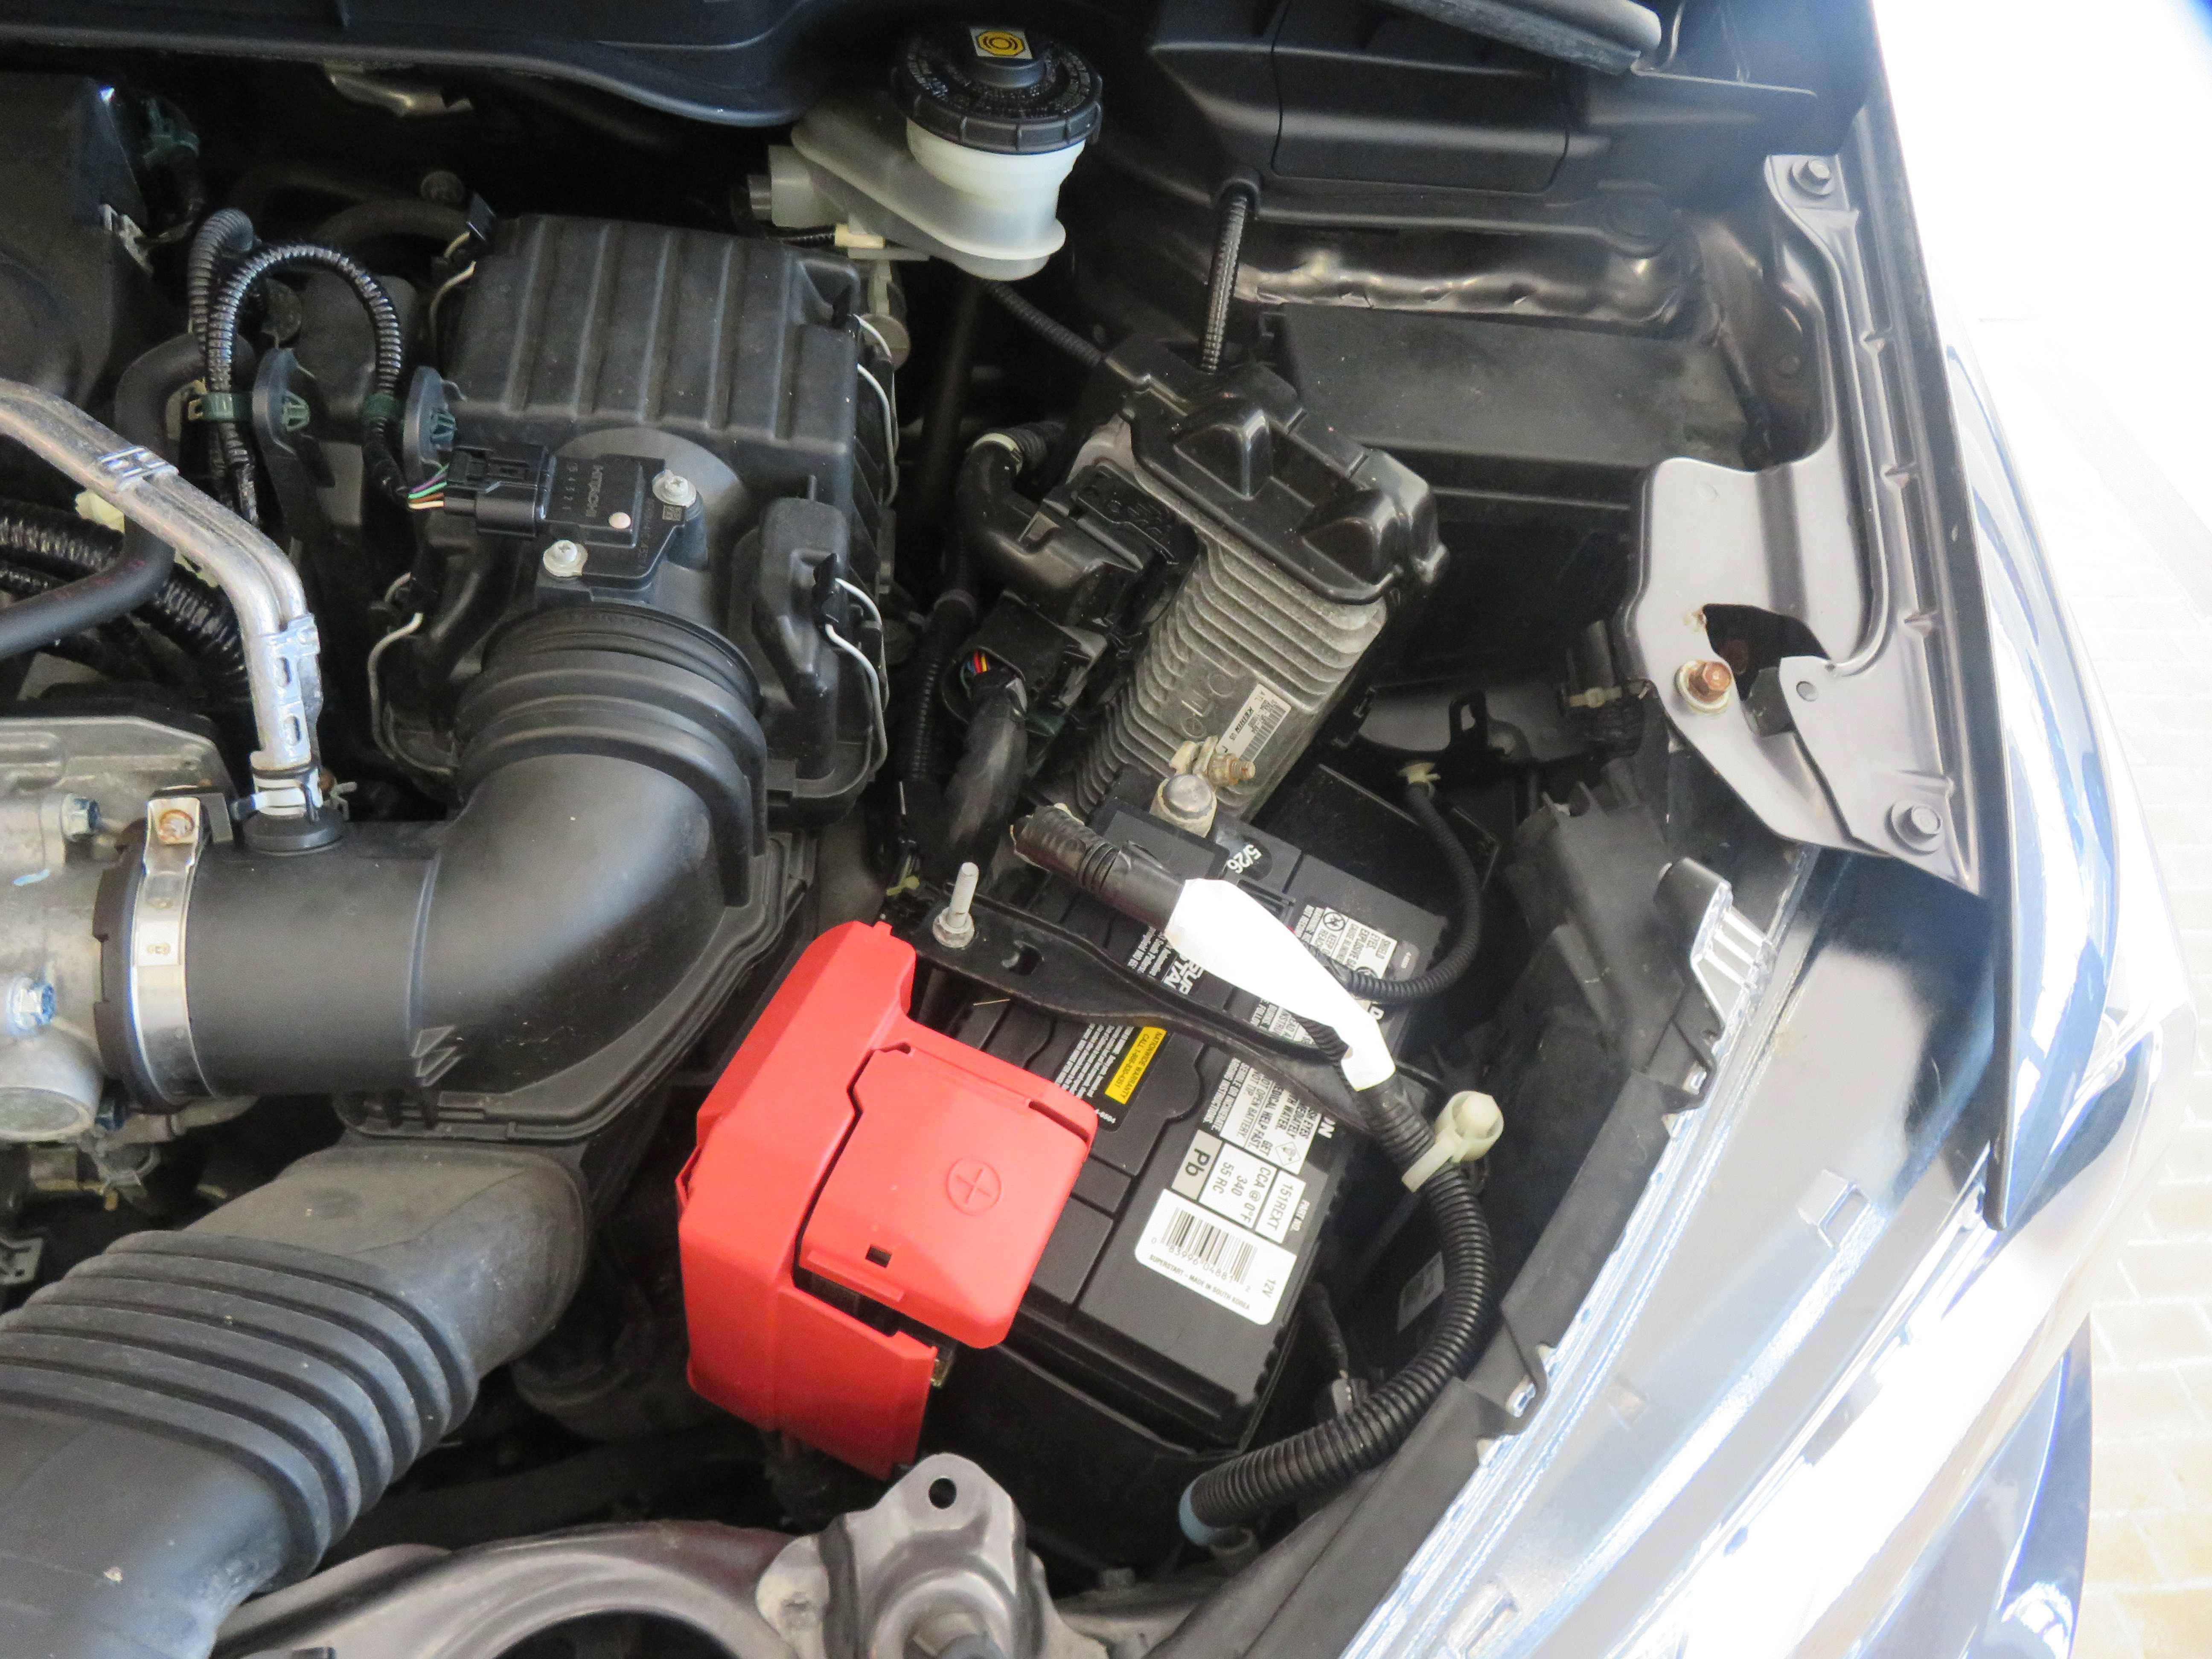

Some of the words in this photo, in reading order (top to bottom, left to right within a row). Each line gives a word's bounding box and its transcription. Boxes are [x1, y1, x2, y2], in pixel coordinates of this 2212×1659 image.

[1234, 706, 1254, 733] KEIHIN
[1227, 844, 1262, 873] 5/26
[1349, 928, 1370, 960] EXPLOSIVE
[1374, 938, 1391, 960] SHIELD
[1136, 1033, 1150, 1049] CALL
[1138, 1031, 1163, 1066] NATIONWIDE
[1119, 1066, 1142, 1099] WARRANTY
[1243, 1083, 1256, 1097] TIP.
[1202, 1078, 1231, 1126] INSTRUCTIONS.
[1250, 1088, 1266, 1108] OPEN
[1236, 1106, 1257, 1139] BATTERY.
[1256, 1110, 1272, 1130] HELP
[1274, 1104, 1295, 1132] WATER.
[1248, 1129, 1264, 1150] FAST.
[1299, 1121, 1313, 1139] EYES
[1258, 1139, 1273, 1156] GET
[1183, 1147, 1211, 1180] Pb
[1219, 1161, 1234, 1177] 55
[1211, 1176, 1228, 1194] RC
[1230, 1174, 1248, 1197] 340
[1252, 1165, 1272, 1190] CCA
[1247, 1189, 1262, 1203] @
[1266, 1182, 1294, 1231] 151REXT
[1238, 1202, 1256, 1223] 0°F
[1295, 1199, 1310, 1220] PART
[1289, 1217, 1303, 1234] NO.
[1168, 1244, 1200, 1266] 83996
[1202, 1262, 1234, 1284] 04881
[1149, 1254, 1184, 1276] SUPERSTART
[1188, 1274, 1205, 1286] MADE
[1212, 1286, 1231, 1300] SOUTH
[1231, 1296, 1251, 1310] KOREA
[1261, 1278, 1276, 1298] 12V
